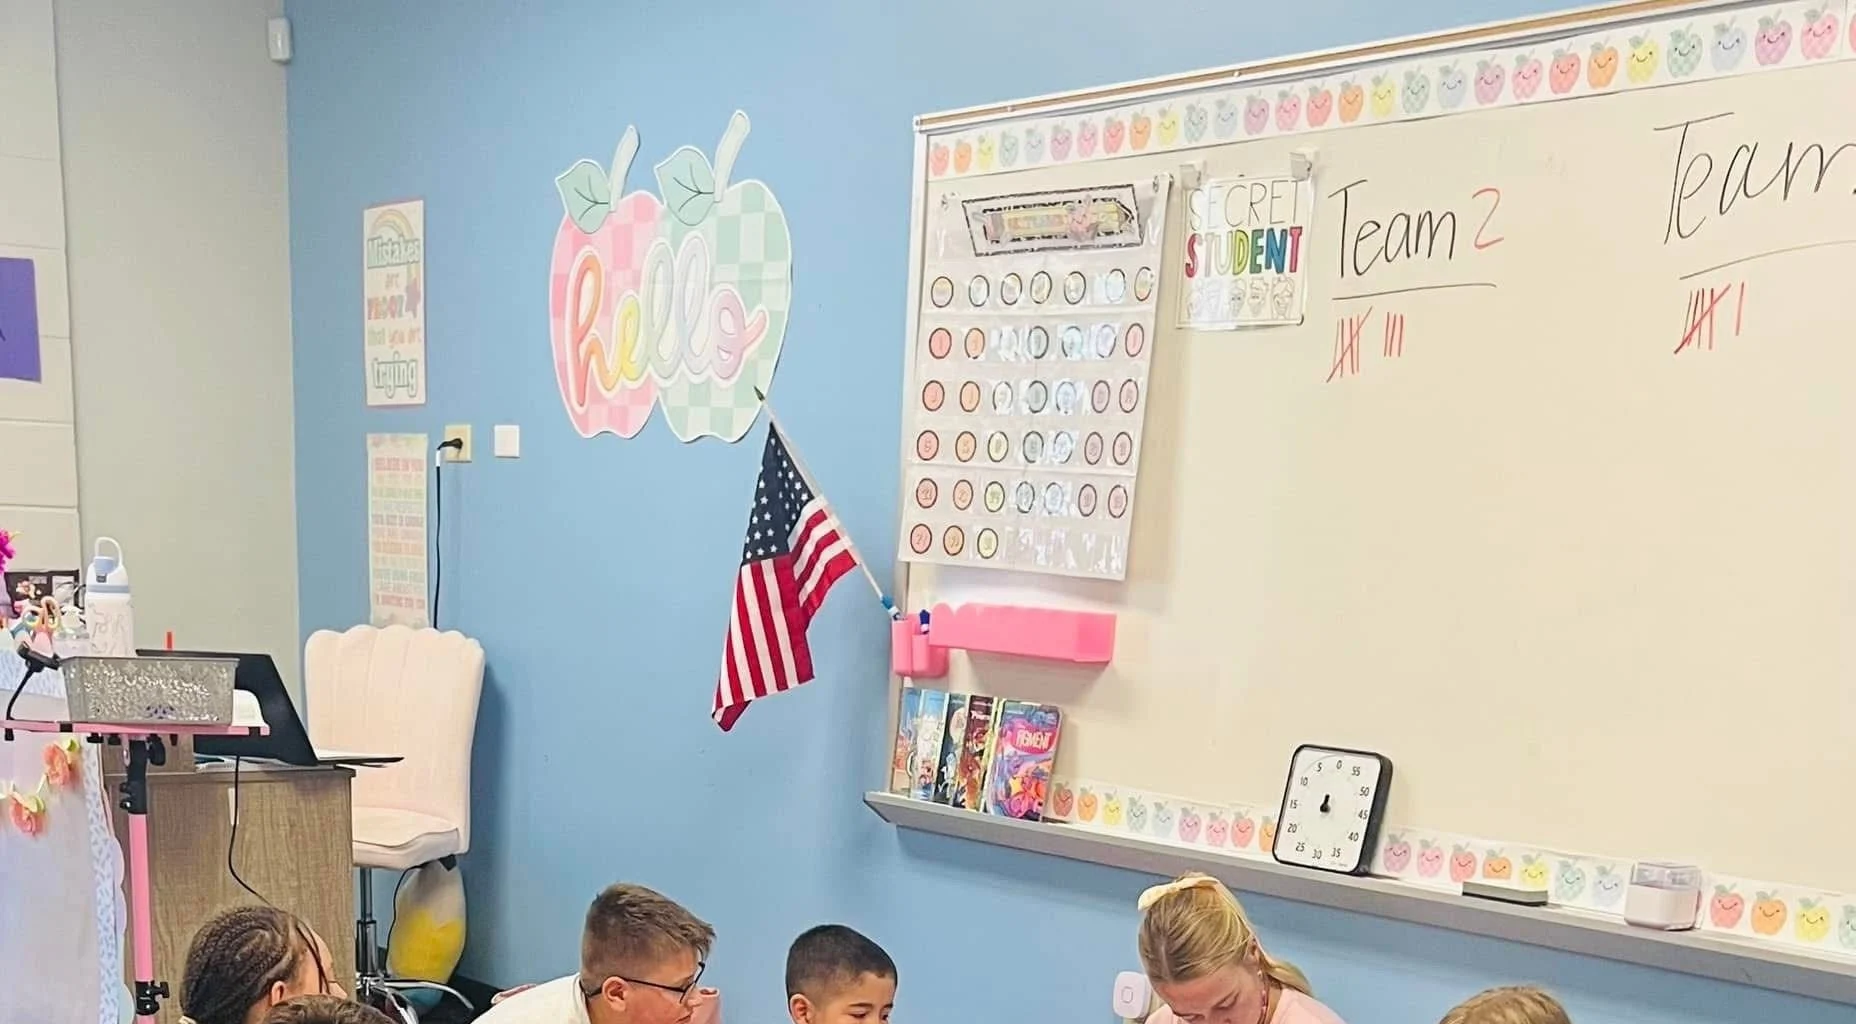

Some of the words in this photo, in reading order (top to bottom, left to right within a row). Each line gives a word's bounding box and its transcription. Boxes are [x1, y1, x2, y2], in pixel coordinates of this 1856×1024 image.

[1189, 180, 1300, 231] SECRET
[1328, 179, 1456, 278] Team
[1472, 188, 1504, 249] 2
[1185, 226, 1303, 278] STUDENT
[570, 234, 767, 407] hello
[372, 351, 418, 399] trying
[1317, 762, 1322, 771] 5
[1336, 760, 1342, 770] 0
[1352, 766, 1360, 775] 55
[1300, 777, 1308, 786] 10
[1359, 787, 1369, 796] 50
[1289, 799, 1297, 808] 15
[1357, 810, 1367, 819] 45
[1287, 823, 1296, 832] 20
[1348, 832, 1358, 841] 40
[1295, 842, 1304, 851] 25
